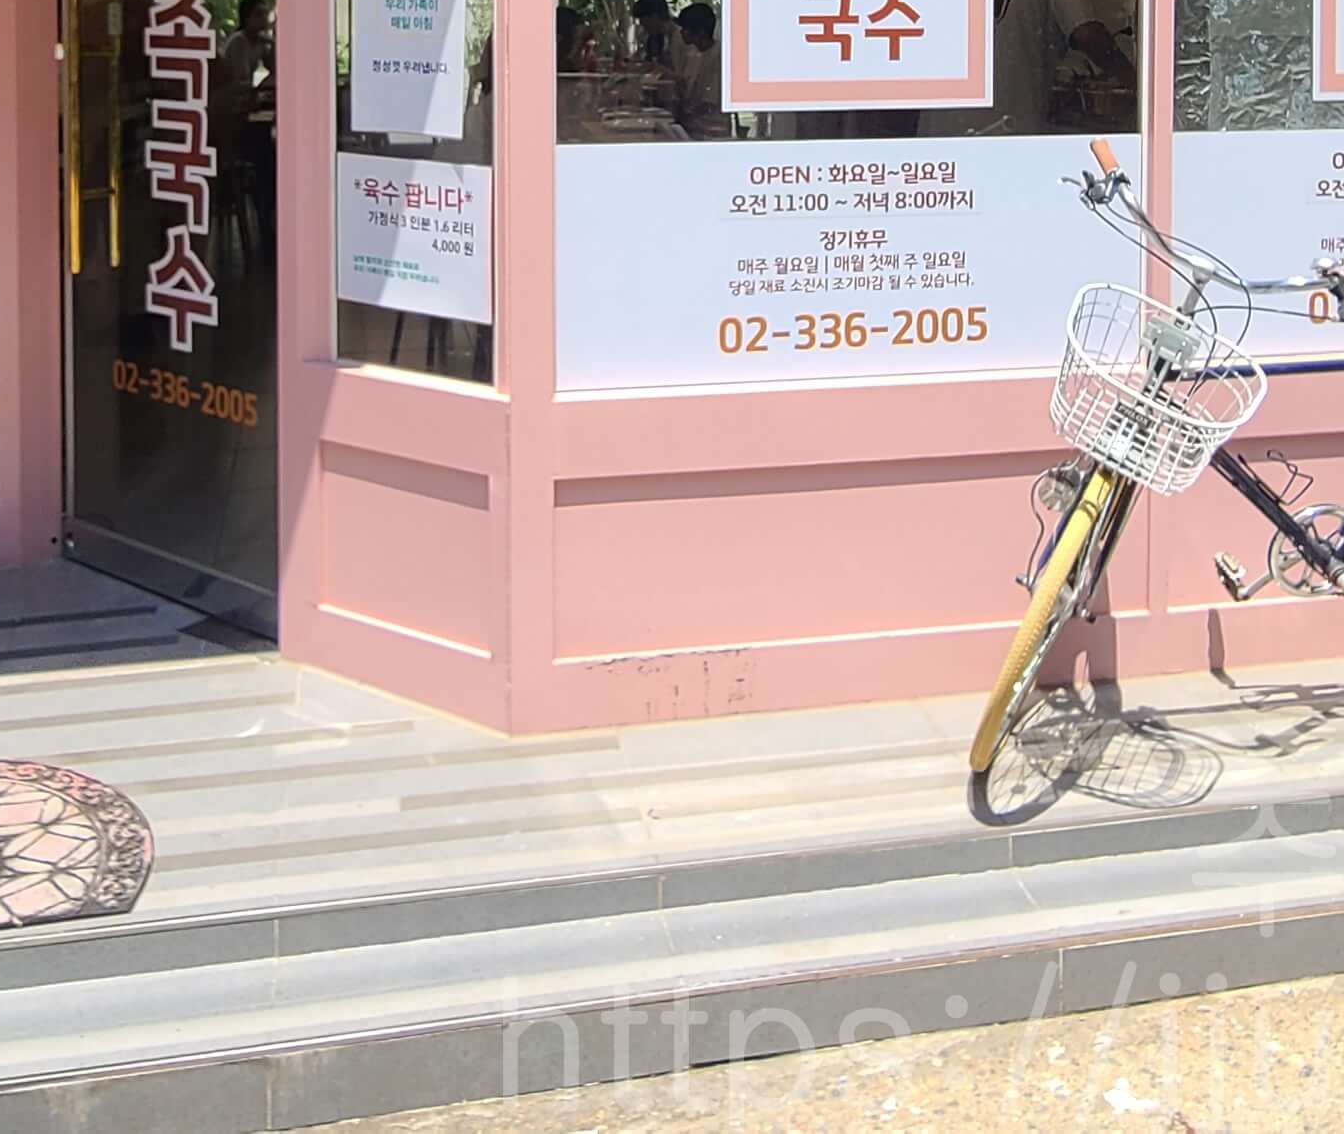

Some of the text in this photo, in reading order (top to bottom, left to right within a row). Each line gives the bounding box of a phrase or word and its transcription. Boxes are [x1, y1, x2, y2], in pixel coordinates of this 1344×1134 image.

[391, 16, 433, 30] 매일 아침
[750, 165, 810, 184] OPEN
[729, 194, 767, 216] 오전
[773, 193, 829, 212] 11:00
[853, 192, 889, 213] 저녁
[895, 189, 974, 210] 8:00까지
[434, 220, 449, 233] 1.6
[452, 221, 474, 237] 리터
[819, 229, 888, 251] 정기휴무
[432, 239, 474, 256] 4,000 원
[737, 258, 768, 275] 매주
[774, 256, 818, 275] 월요일
[834, 254, 864, 272] 매월
[869, 253, 899, 271] 첫째
[904, 253, 918, 270] 주
[922, 251, 965, 270] 일요일
[729, 279, 755, 296] 당일
[759, 279, 785, 293] 재료
[790, 277, 828, 293] 소진시
[832, 275, 884, 291] 조기마감
[904, 275, 918, 289] 수
[921, 272, 974, 289] 있습니다.
[718, 306, 988, 353] 02-336-2005
[113, 357, 257, 426] 02-336-2005
